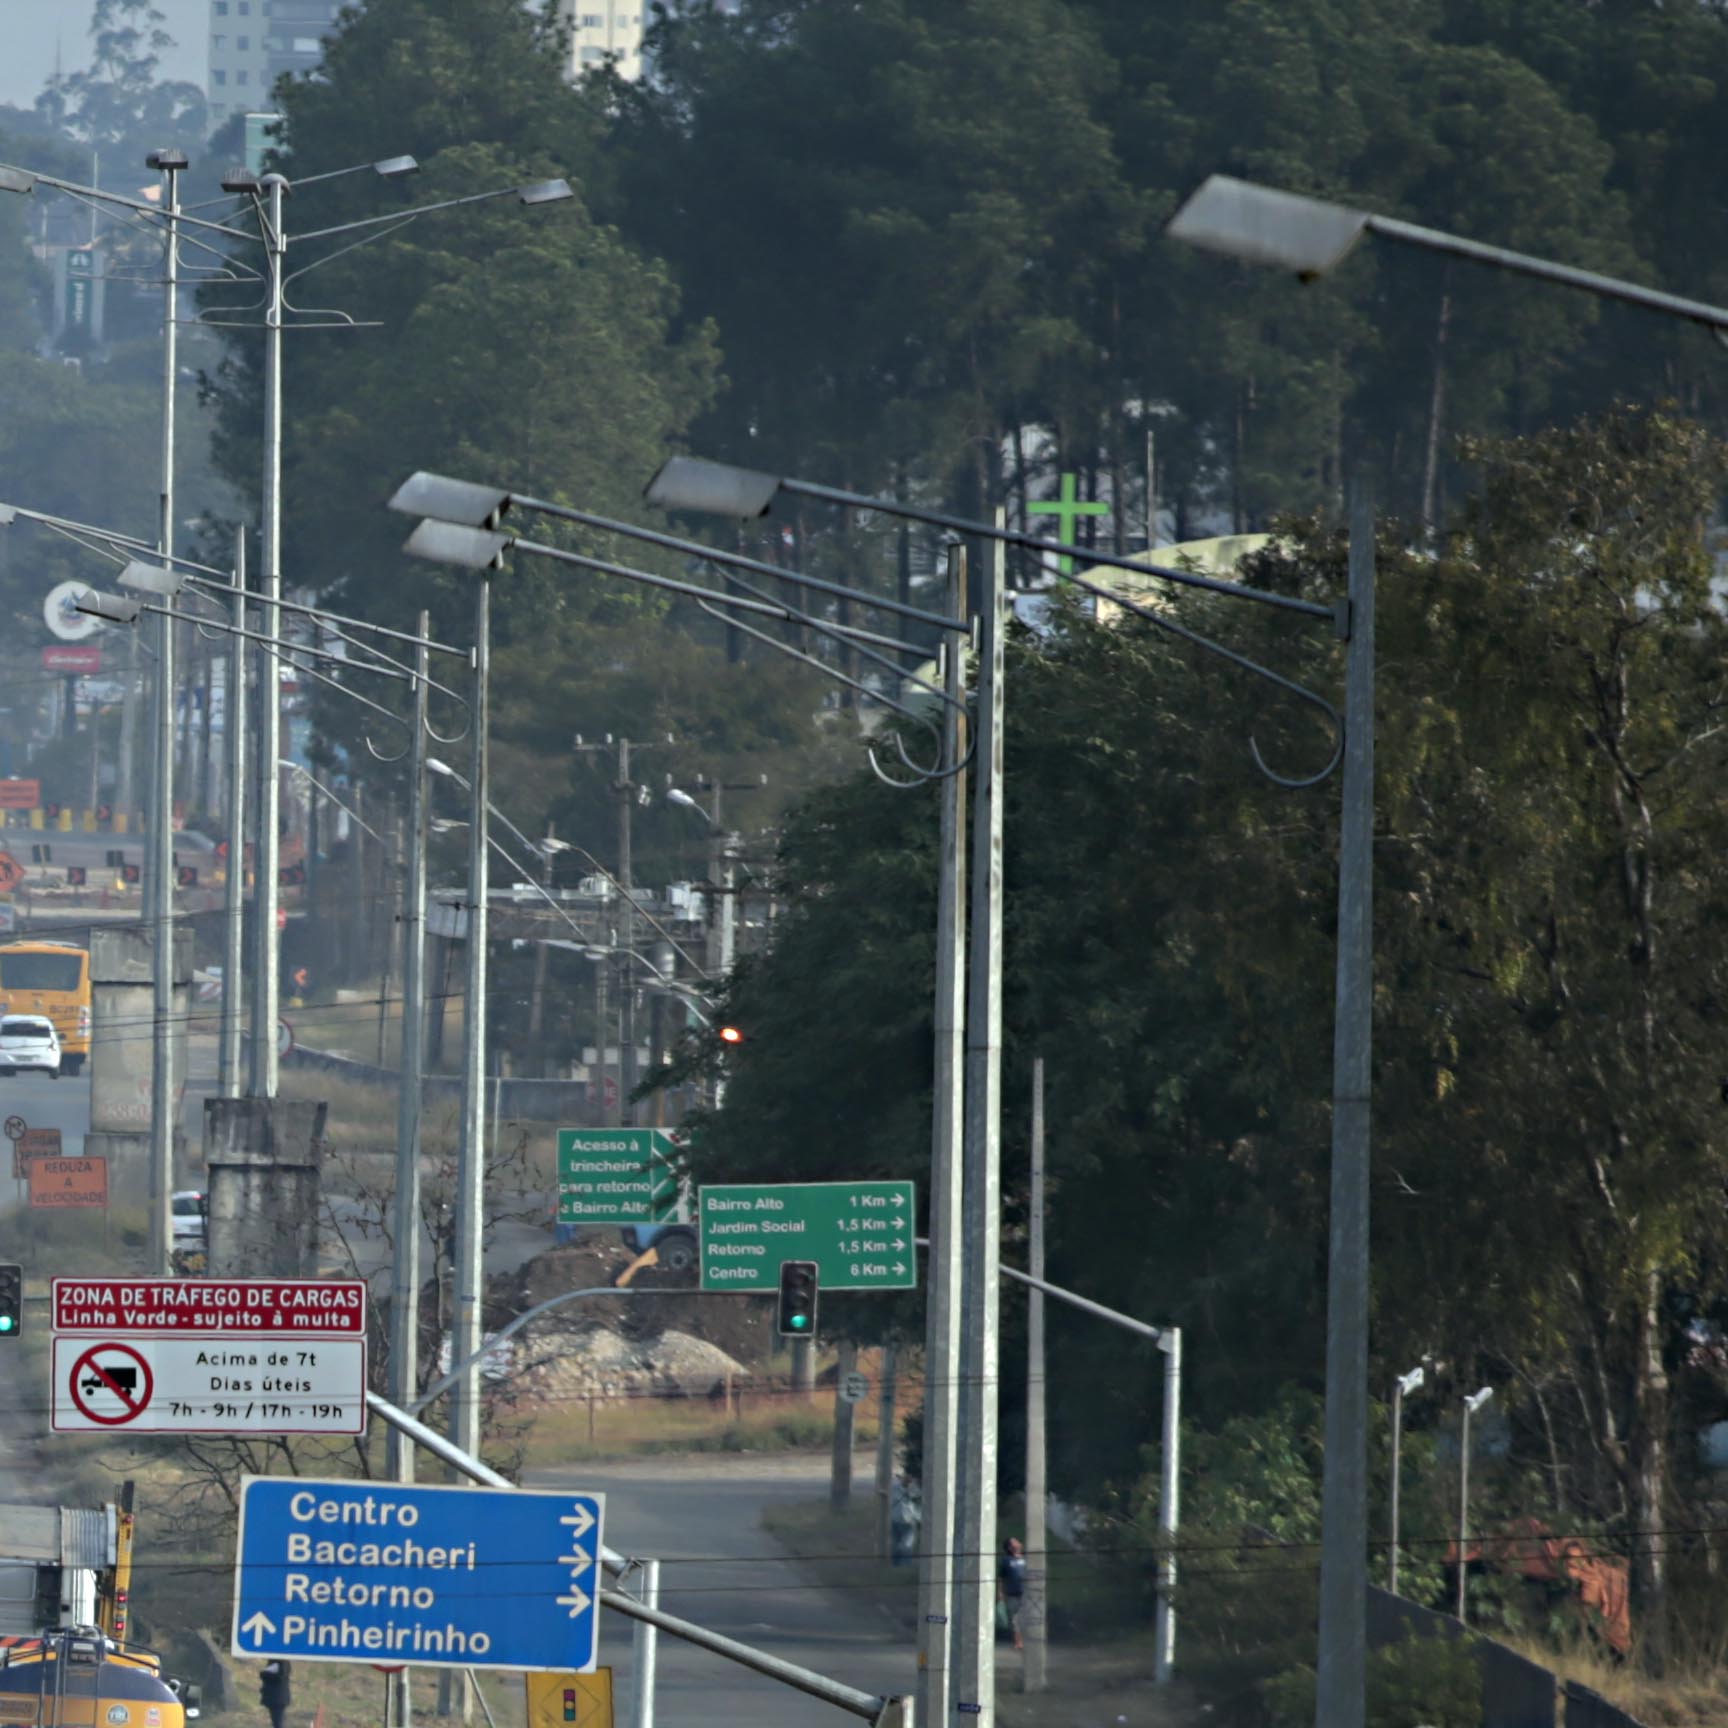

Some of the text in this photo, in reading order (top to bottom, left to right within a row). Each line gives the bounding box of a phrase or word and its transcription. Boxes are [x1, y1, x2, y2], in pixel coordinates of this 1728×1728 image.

[572, 1139, 639, 1152] Acesso à
[45, 1161, 92, 1173] REDUZA
[571, 1159, 641, 1172] trincheira
[64, 1177, 72, 1187] A
[559, 1182, 650, 1195] para retorno
[573, 1203, 617, 1214] Bairro
[708, 1196, 885, 1210] Bairro Alto 1 Km
[708, 1219, 886, 1235] Jardim Social 1,5 Km
[708, 1240, 886, 1256] Retorno 1,5 Km
[709, 1263, 887, 1279] Centro 6 Km
[61, 1284, 359, 1307] ZONA DE TRÁFEGO DE CARGAS
[61, 1310, 116, 1325] Linha
[124, 1311, 178, 1325] Verde
[193, 1311, 262, 1330] sujeito
[272, 1311, 282, 1326] à
[293, 1312, 350, 1327] multa
[196, 1352, 317, 1367] Acima de 7t
[210, 1377, 311, 1391] Dias úteis
[169, 1403, 192, 1416] 7h
[213, 1403, 237, 1417] 9h
[262, 1404, 292, 1417] 17h
[312, 1404, 342, 1418] 19h
[290, 1491, 418, 1527] Centro
[287, 1533, 477, 1571] Bacacheri
[285, 1573, 434, 1609] Retorno
[283, 1615, 490, 1654] Pinheirinho
